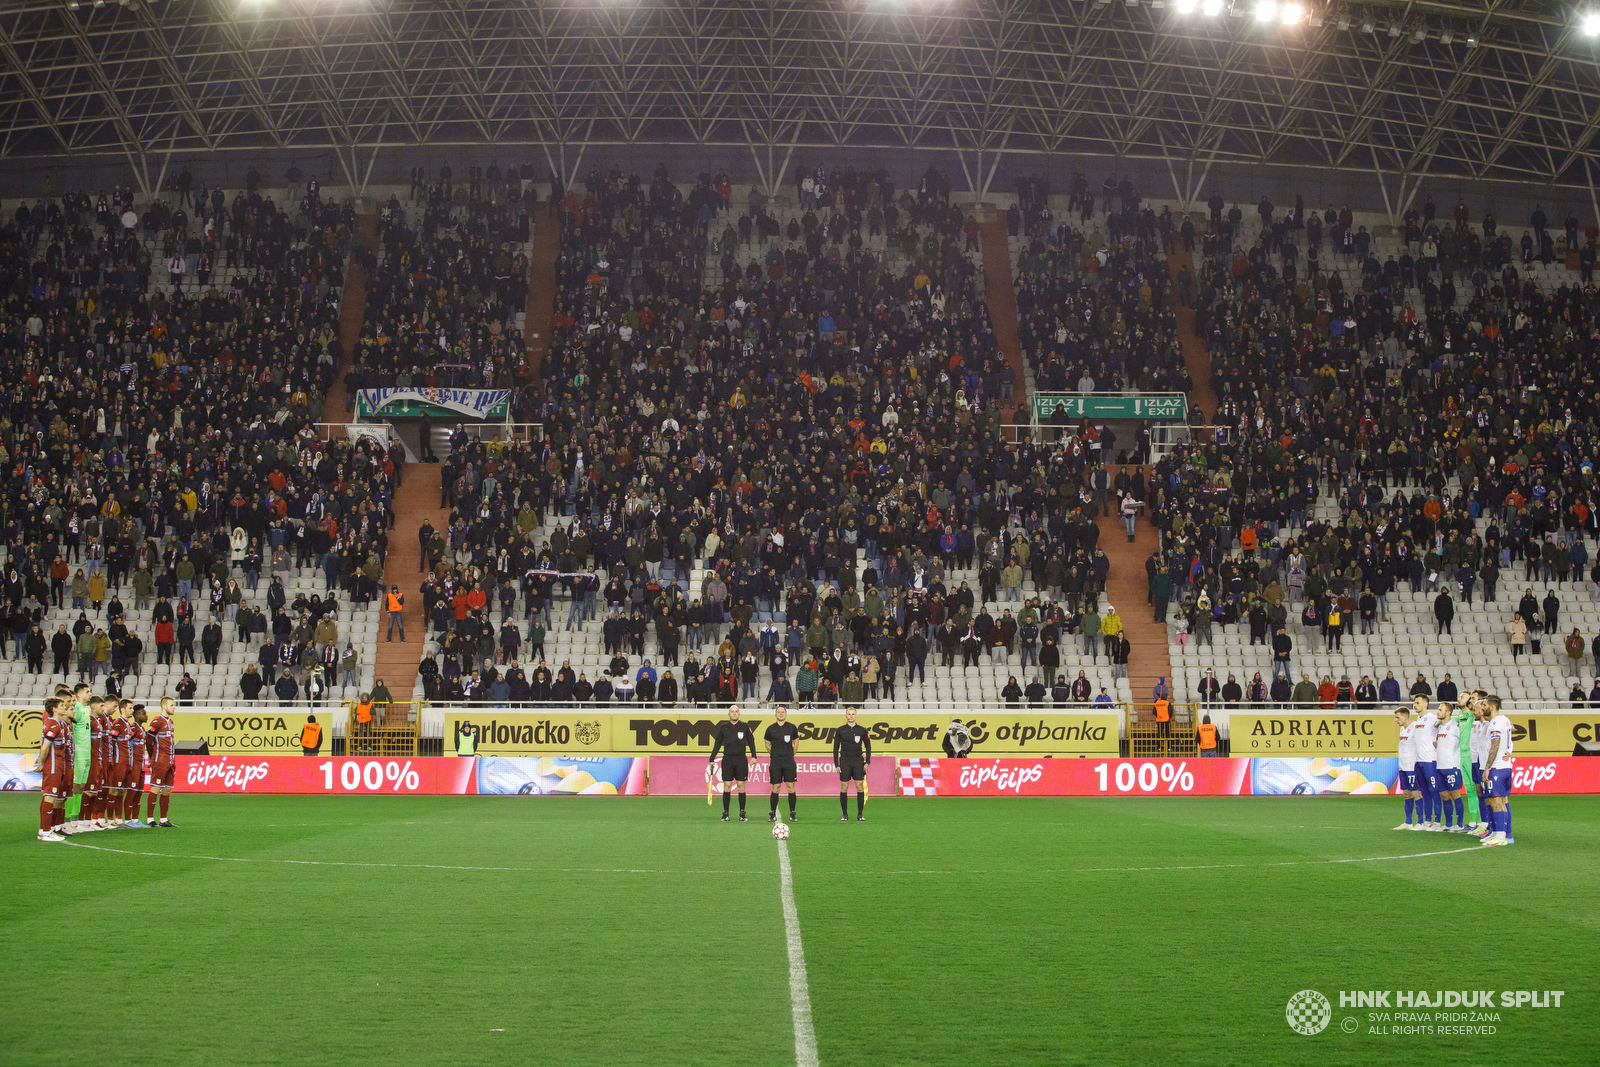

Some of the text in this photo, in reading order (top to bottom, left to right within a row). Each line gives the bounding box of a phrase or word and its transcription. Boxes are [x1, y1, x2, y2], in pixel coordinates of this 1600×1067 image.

[1037, 398, 1074, 406] IZLAZ
[1144, 399, 1181, 407] IZLAZ
[1041, 407, 1070, 415] EXT
[1148, 408, 1177, 416] EXIT
[210, 717, 287, 730] TOYOTA
[1251, 720, 1374, 736] ADRIATIC
[454, 719, 570, 744] Karlovačko
[240, 733, 301, 747] ČONDIĆ
[1251, 740, 1374, 749] OSIGURANJE
[319, 760, 419, 791] 100%
[1094, 761, 1194, 792] 100%
[1408, 775, 1415, 784] 77
[1447, 775, 1456, 784] 26
[1430, 776, 1436, 785] 9
